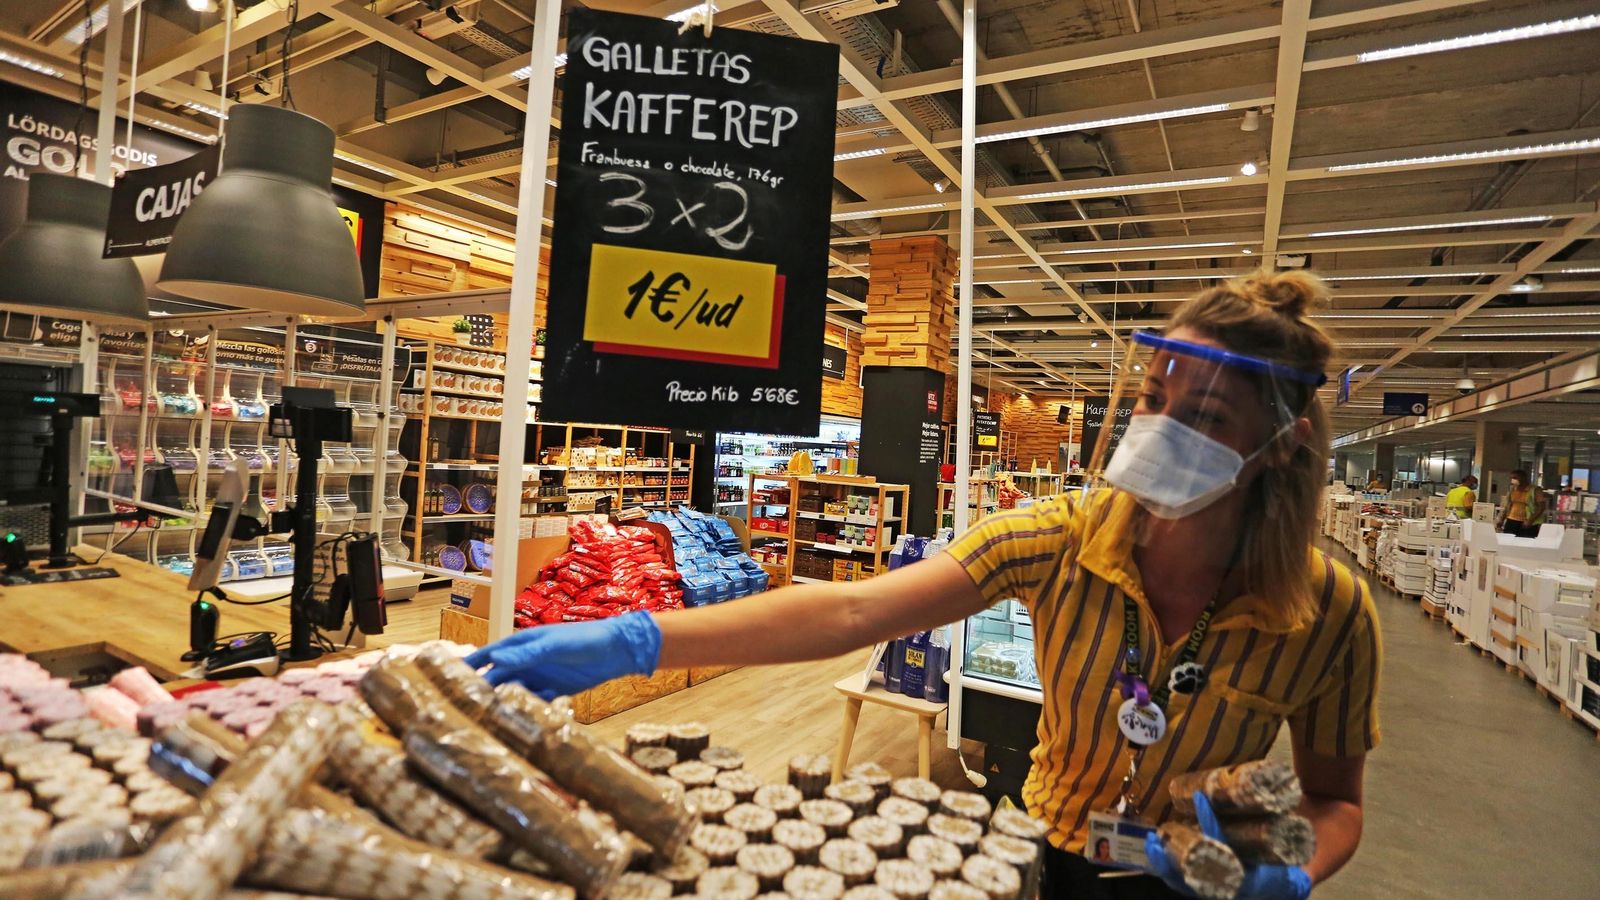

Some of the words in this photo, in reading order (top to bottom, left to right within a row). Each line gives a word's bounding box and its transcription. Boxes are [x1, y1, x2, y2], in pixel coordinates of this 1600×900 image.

[582, 36, 752, 84] GALLETAS
[583, 82, 798, 148] KAFFEREP
[581, 141, 650, 170] Frambuesa
[664, 162, 673, 171] o
[680, 156, 742, 181] chocolate,
[748, 167, 784, 188] 176gr
[599, 172, 655, 233] 3
[670, 198, 706, 228] x
[705, 181, 754, 250] 2
[623, 269, 744, 330] 1€/ud
[50, 332, 78, 343] elige
[244, 344, 256, 352] las
[257, 347, 285, 355] golosin
[665, 380, 707, 402] Precio
